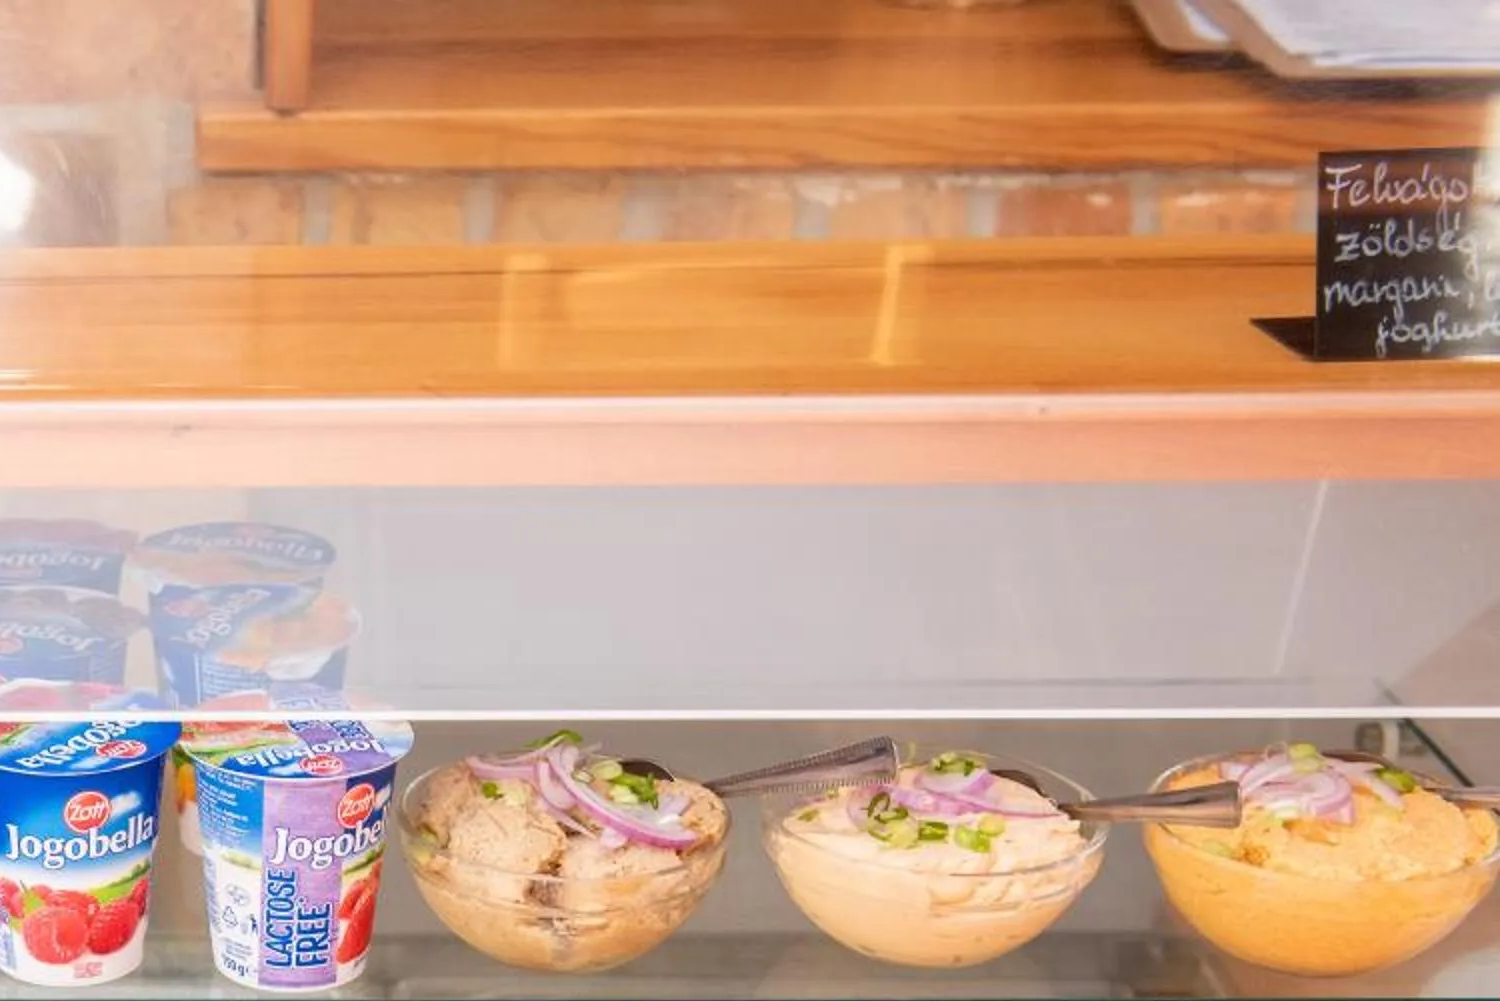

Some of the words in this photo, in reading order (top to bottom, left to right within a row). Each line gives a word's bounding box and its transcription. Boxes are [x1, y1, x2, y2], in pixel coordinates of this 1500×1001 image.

[69, 801, 106, 822] Zott
[5, 812, 154, 870] Jogobella
[265, 868, 296, 968] LACTOSE
